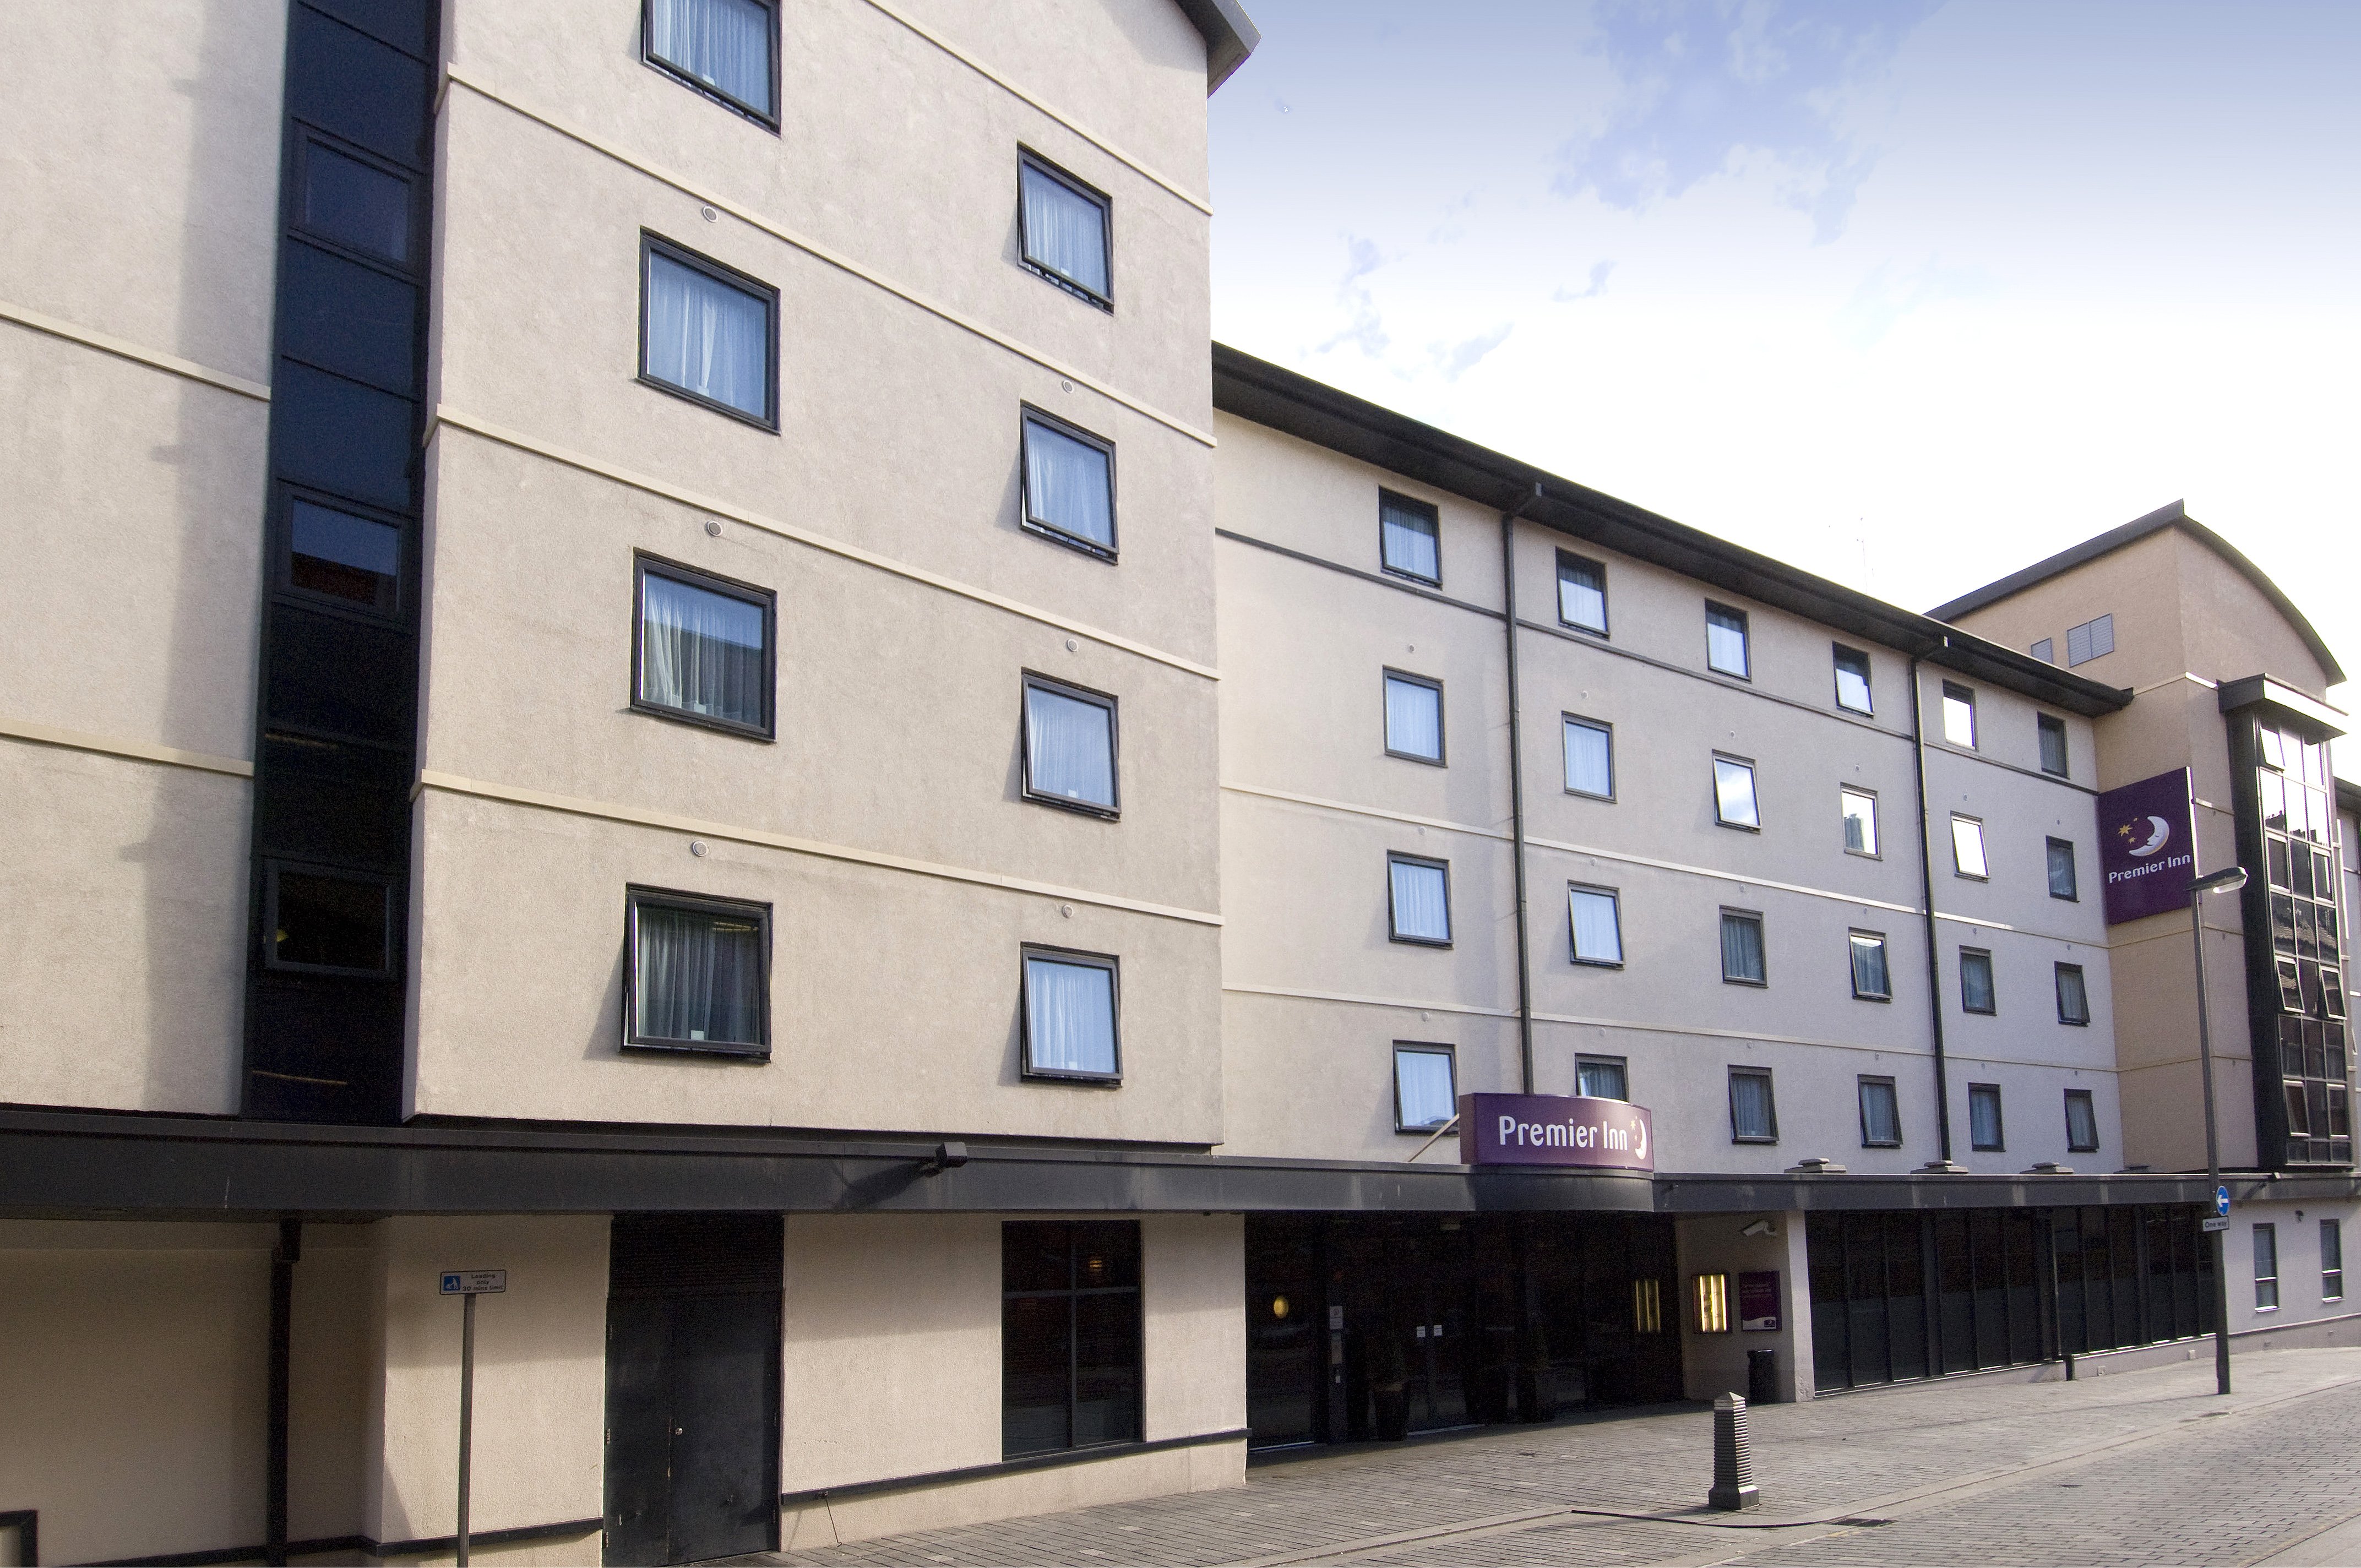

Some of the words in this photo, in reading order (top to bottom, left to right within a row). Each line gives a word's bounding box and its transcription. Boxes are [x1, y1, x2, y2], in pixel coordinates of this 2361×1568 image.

[2109, 862, 2165, 884] Premier
[2168, 854, 2190, 868] Inn
[1499, 1116, 1598, 1148] Premier
[1603, 1121, 1628, 1151] Inn
